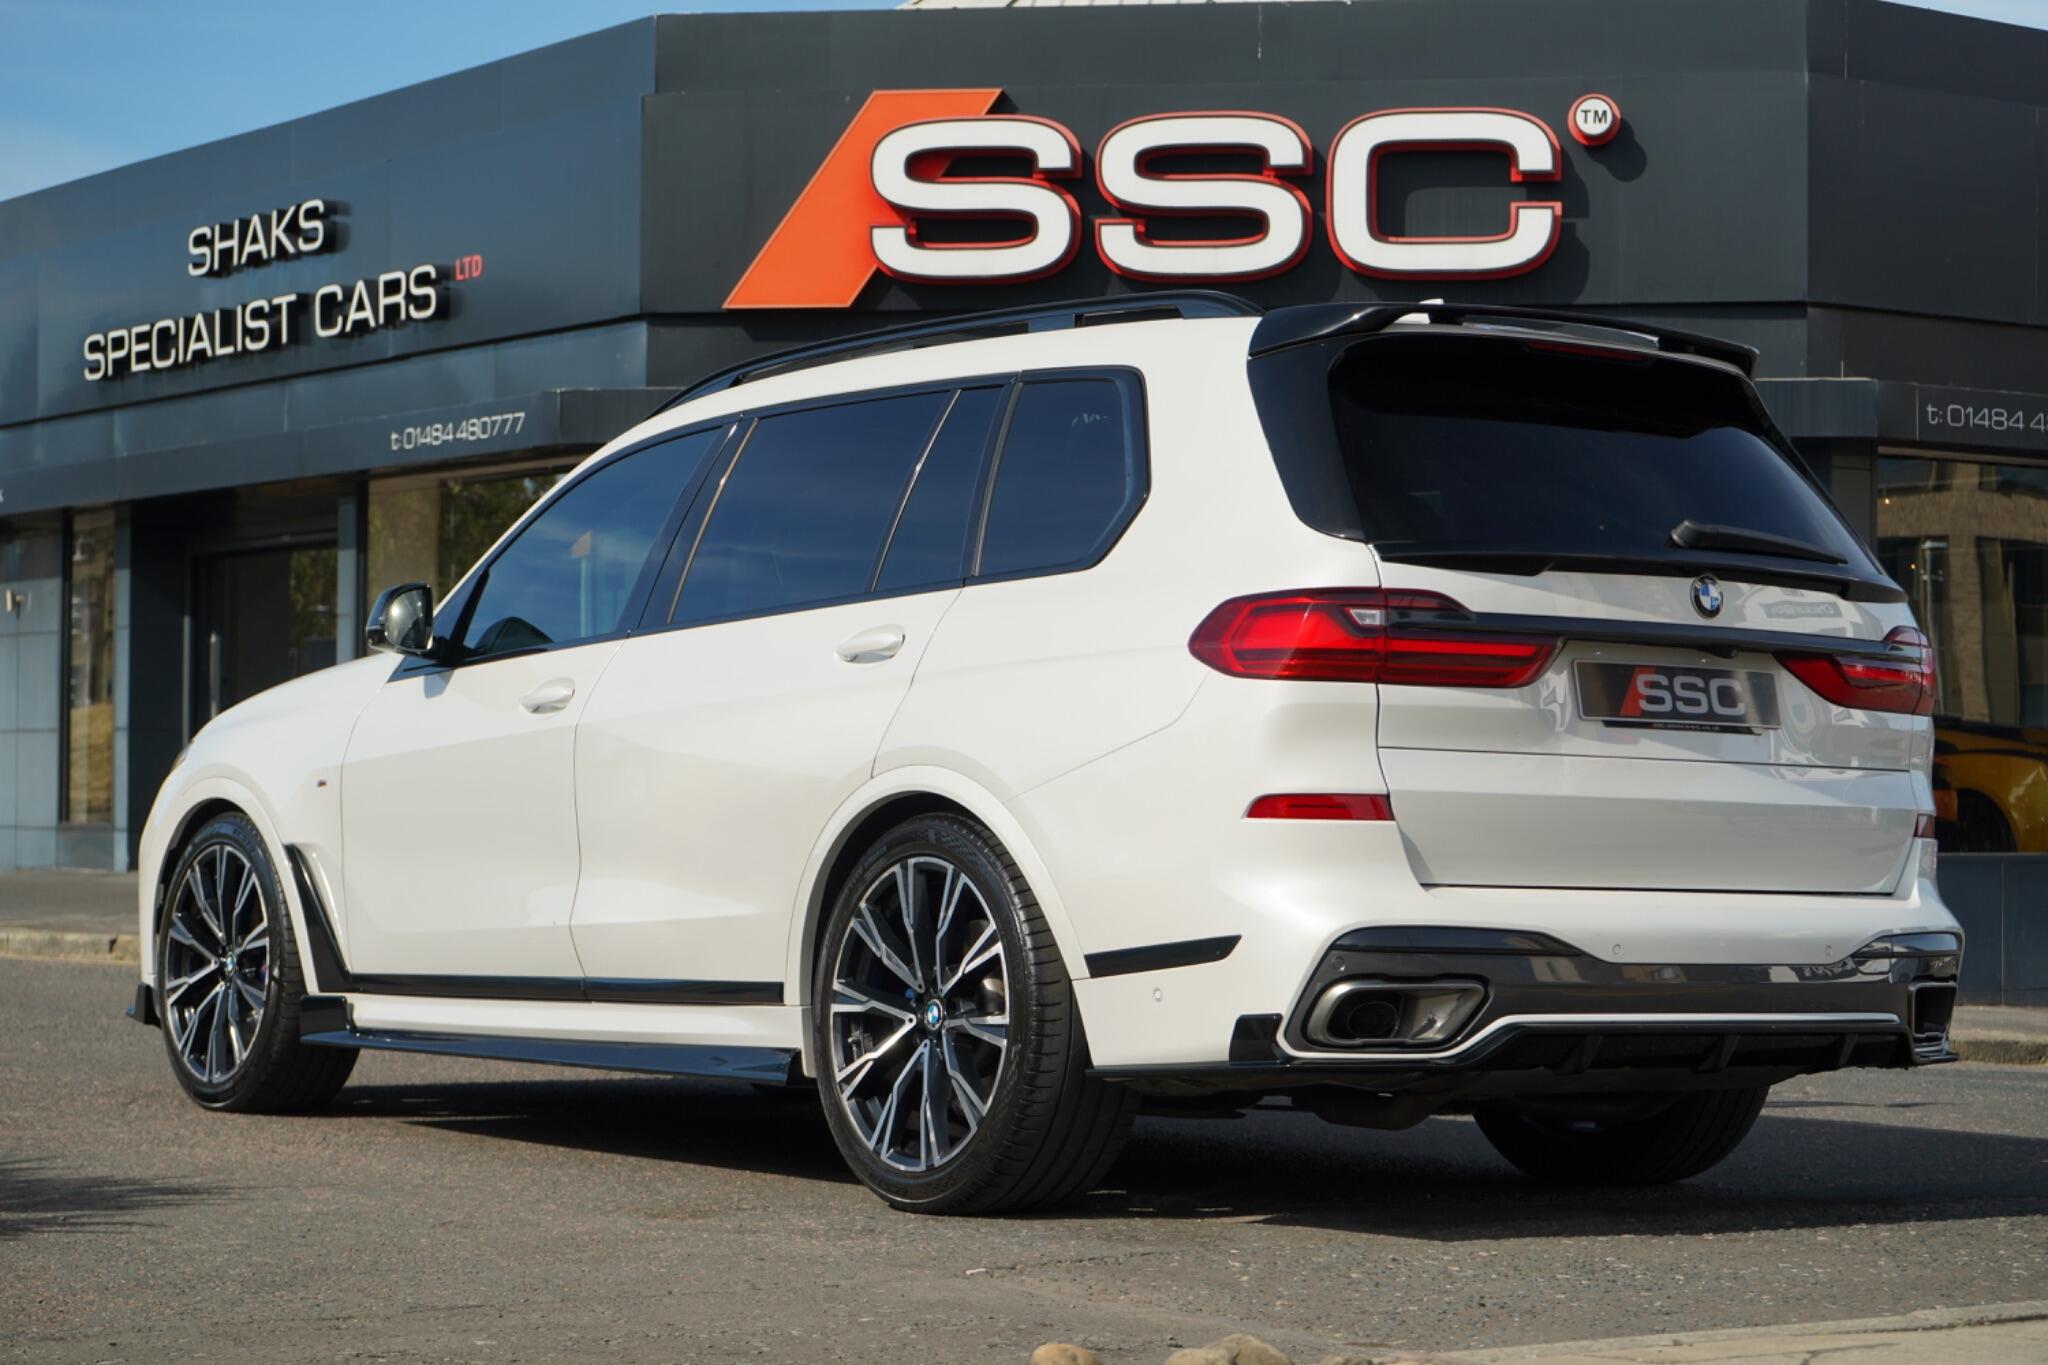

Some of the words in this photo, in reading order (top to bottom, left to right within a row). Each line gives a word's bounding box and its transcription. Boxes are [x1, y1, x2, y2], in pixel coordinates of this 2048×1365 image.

[1580, 109, 1608, 125] TM
[869, 107, 1562, 282] SSC
[187, 198, 325, 276] SHAKS
[83, 293, 297, 381] SPECIALIST
[314, 264, 437, 338] CARS
[454, 253, 483, 281] LTD
[455, 411, 526, 441] 480777
[2030, 412, 2048, 432] 4
[1636, 673, 1746, 716] SSC
